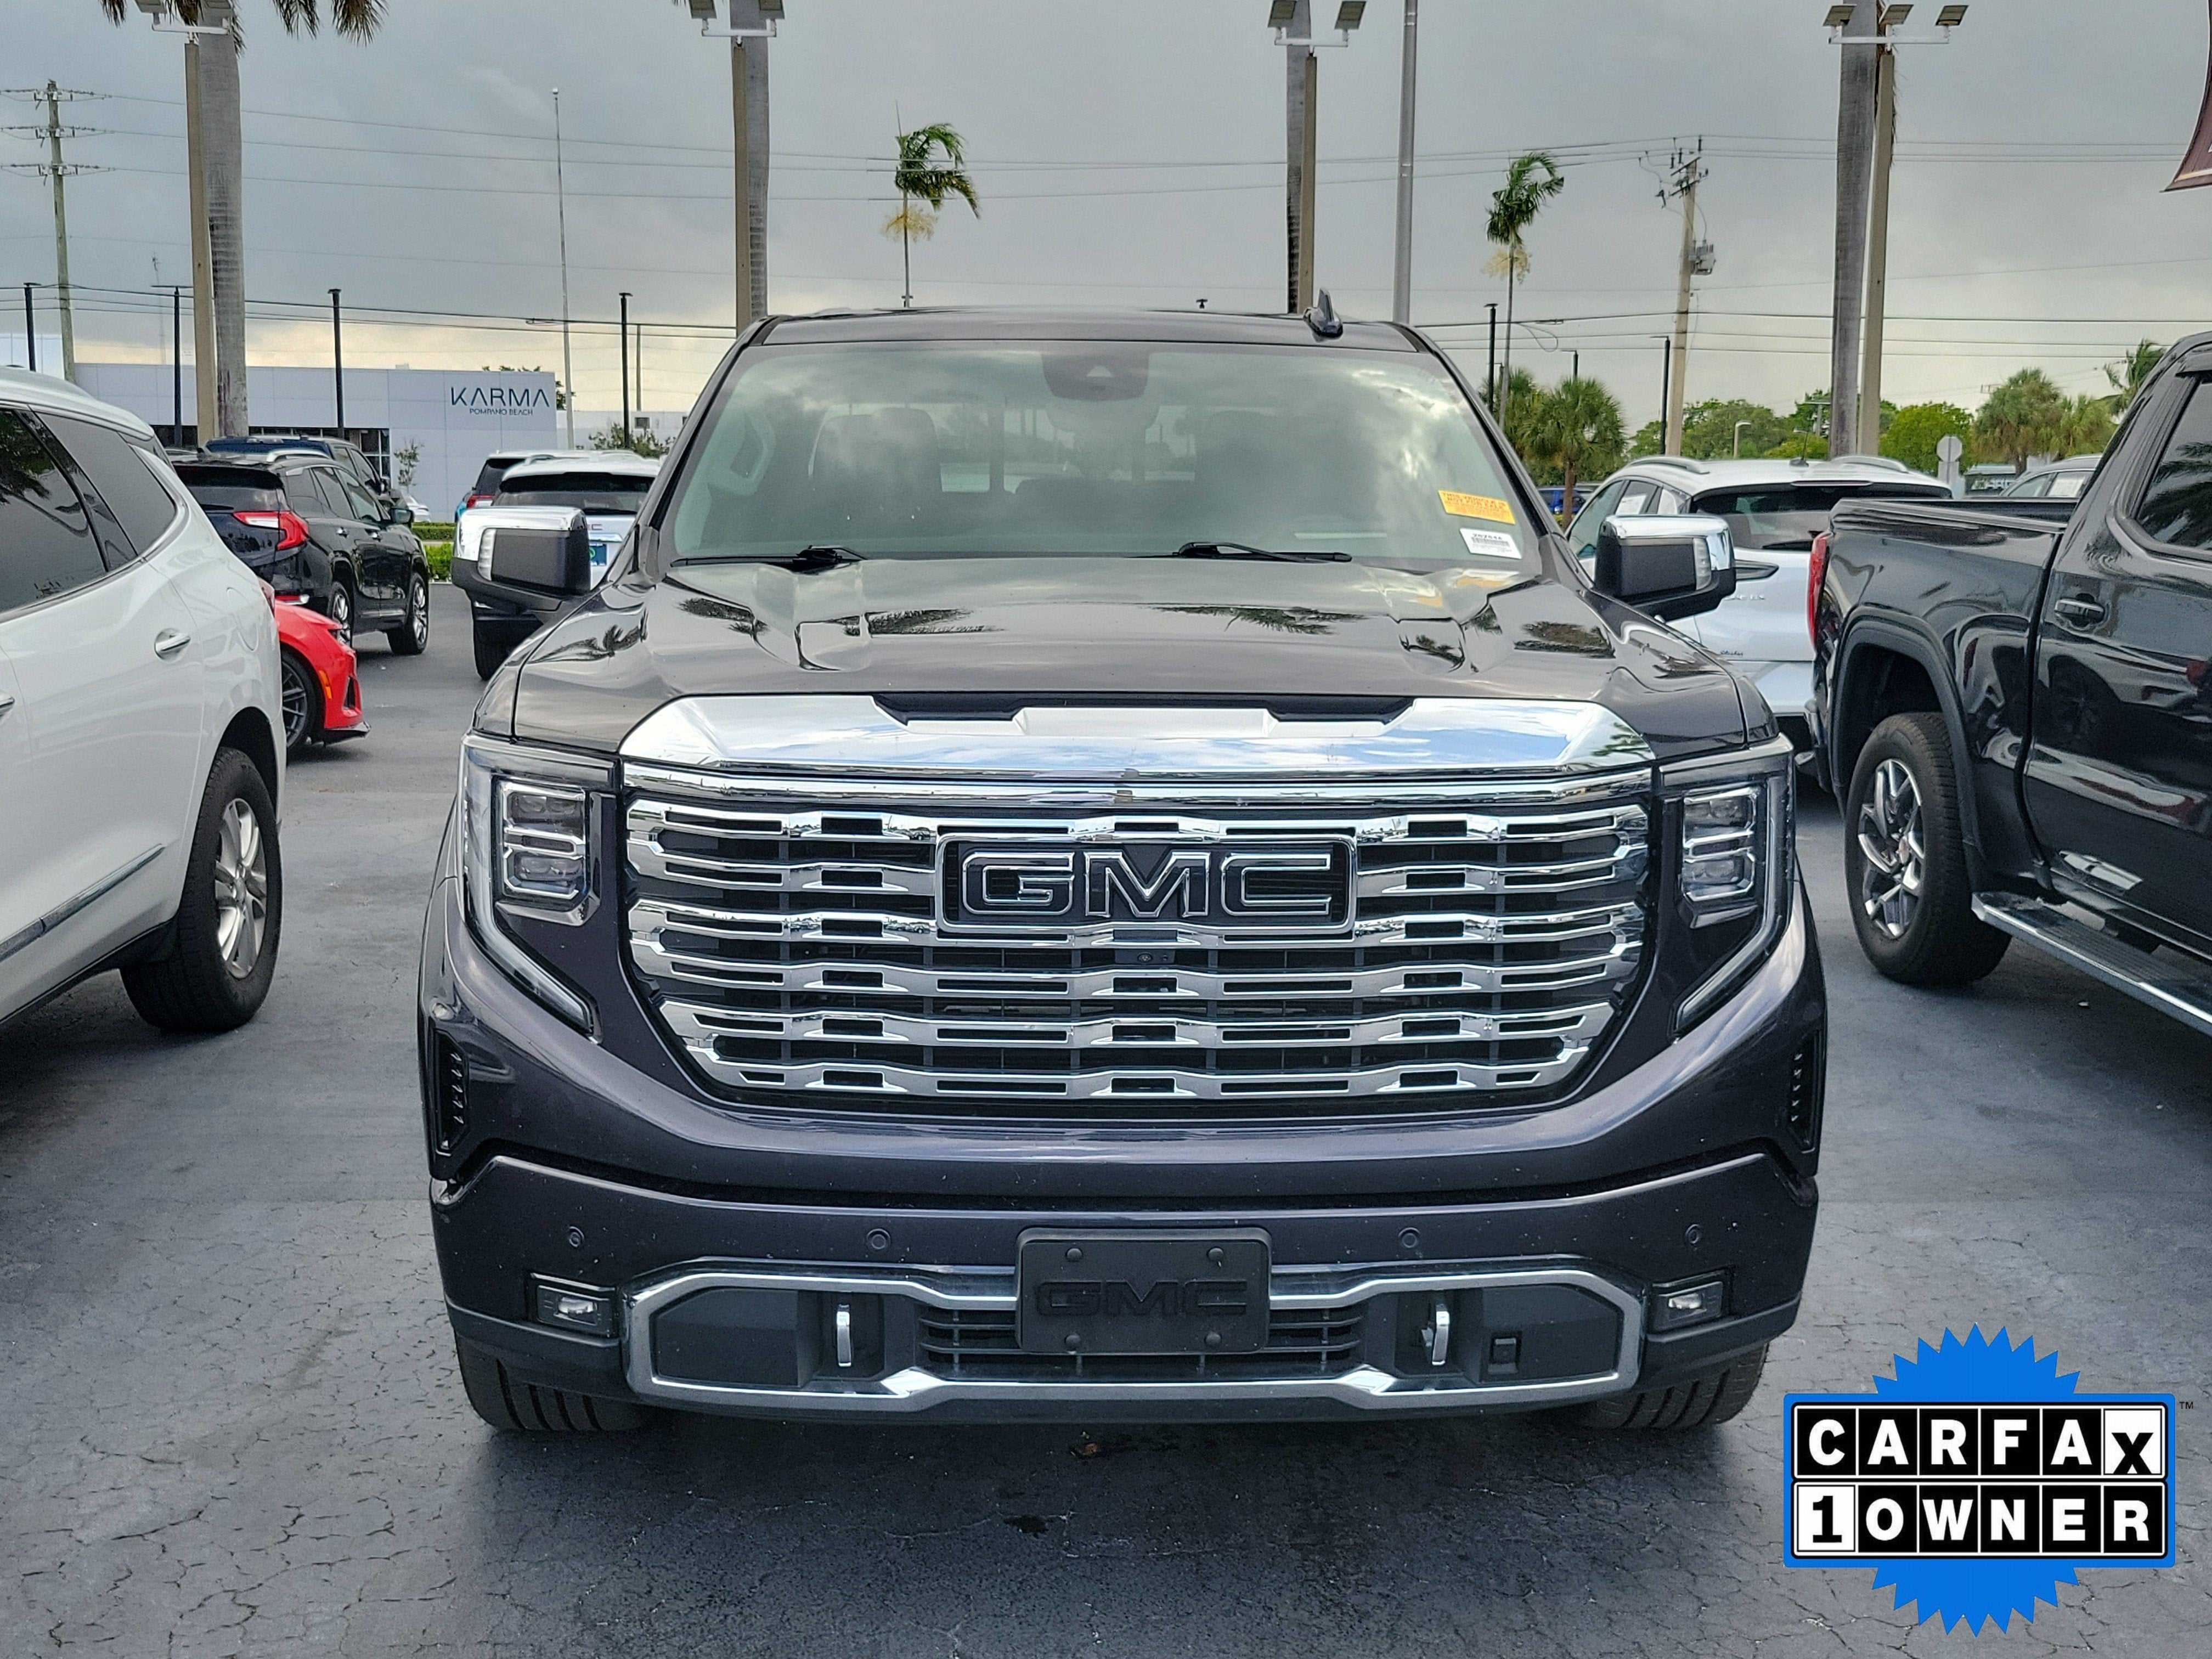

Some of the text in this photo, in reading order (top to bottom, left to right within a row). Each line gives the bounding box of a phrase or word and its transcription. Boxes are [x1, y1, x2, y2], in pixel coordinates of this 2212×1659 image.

[451, 387, 550, 407] KARMA
[962, 851, 1332, 917] GMC
[1037, 1280, 1248, 1316] GMC
